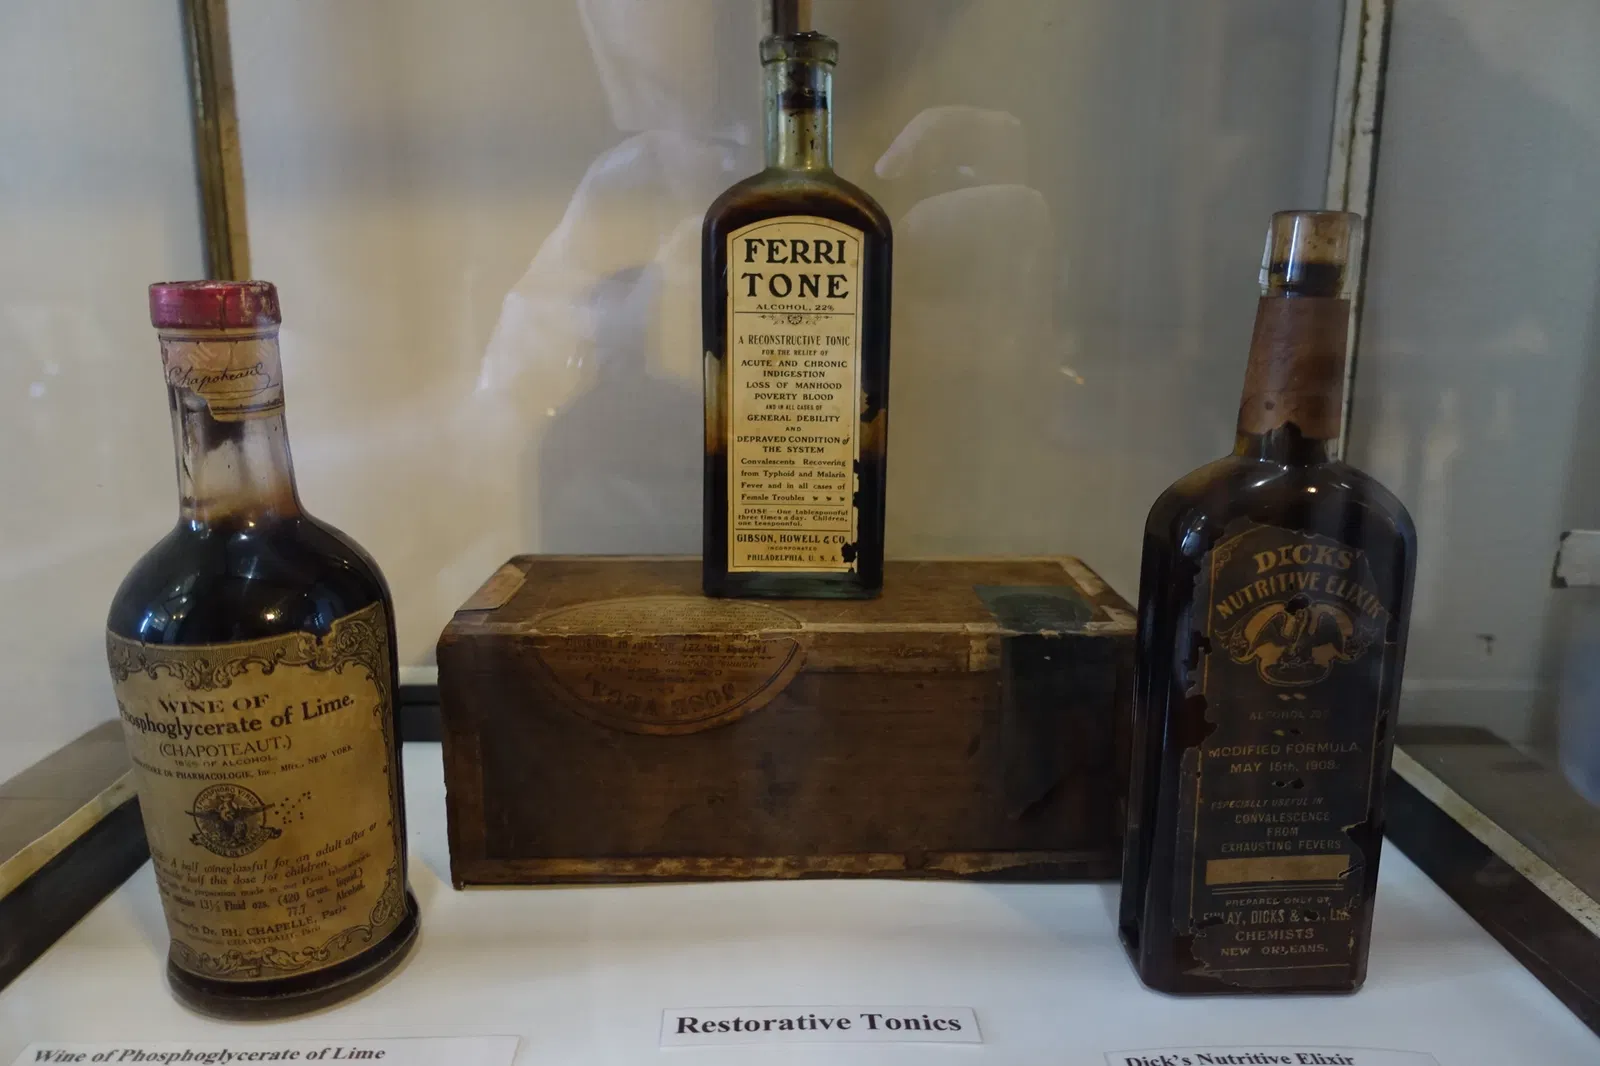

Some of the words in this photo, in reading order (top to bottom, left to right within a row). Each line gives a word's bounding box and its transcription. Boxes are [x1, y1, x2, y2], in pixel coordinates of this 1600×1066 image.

[744, 239, 846, 265] FERRI
[741, 273, 849, 299] TONE
[738, 336, 743, 344] A
[749, 335, 821, 345] RECONSTRUCTIVE
[826, 336, 850, 345] TONIC
[803, 459, 846, 467] Recovering
[737, 534, 777, 544] GIBSON,
[780, 535, 820, 543] HOWELL
[823, 536, 829, 544] &
[1216, 571, 1321, 619] NUTRITIVE
[1325, 575, 1385, 619] ELIXIR
[159, 695, 224, 713] WINE
[232, 694, 270, 712] OF
[271, 706, 294, 727] of
[302, 695, 354, 721] Lime.
[308, 753, 328, 764] NEW
[333, 745, 353, 756] YORK
[1208, 744, 1281, 758] MODIFIED
[1230, 762, 1262, 773] MAY
[1235, 811, 1330, 824] CONVALESCENCE
[1267, 827, 1299, 836] FROM
[204, 860, 267, 875] wineglassful
[274, 857, 289, 869] for
[296, 854, 309, 863] an
[316, 839, 342, 857] adult
[345, 829, 365, 847] after
[1221, 841, 1292, 852] EXHAUSTING
[1299, 839, 1341, 850] FEVERS
[210, 875, 227, 885] this
[233, 875, 256, 884] dose
[262, 875, 277, 884] for
[1284, 896, 1312, 904] ONLY
[322, 905, 347, 919] Paris
[1251, 909, 1285, 924] DICKS
[1290, 910, 1300, 922] &
[1235, 928, 1315, 941] CHEMISTS
[1221, 947, 1251, 956] NEW
[676, 1014, 851, 1034] Restorative
[860, 1013, 961, 1031] Tonics
[33, 1049, 86, 1064] Wine
[92, 1049, 117, 1064] of
[115, 1048, 300, 1065] Phosphoglycerate
[306, 1047, 331, 1062] of
[333, 1046, 386, 1061] Lime
[1194, 1052, 1291, 1065] Nutritive
[1294, 1052, 1354, 1066] Elixir
